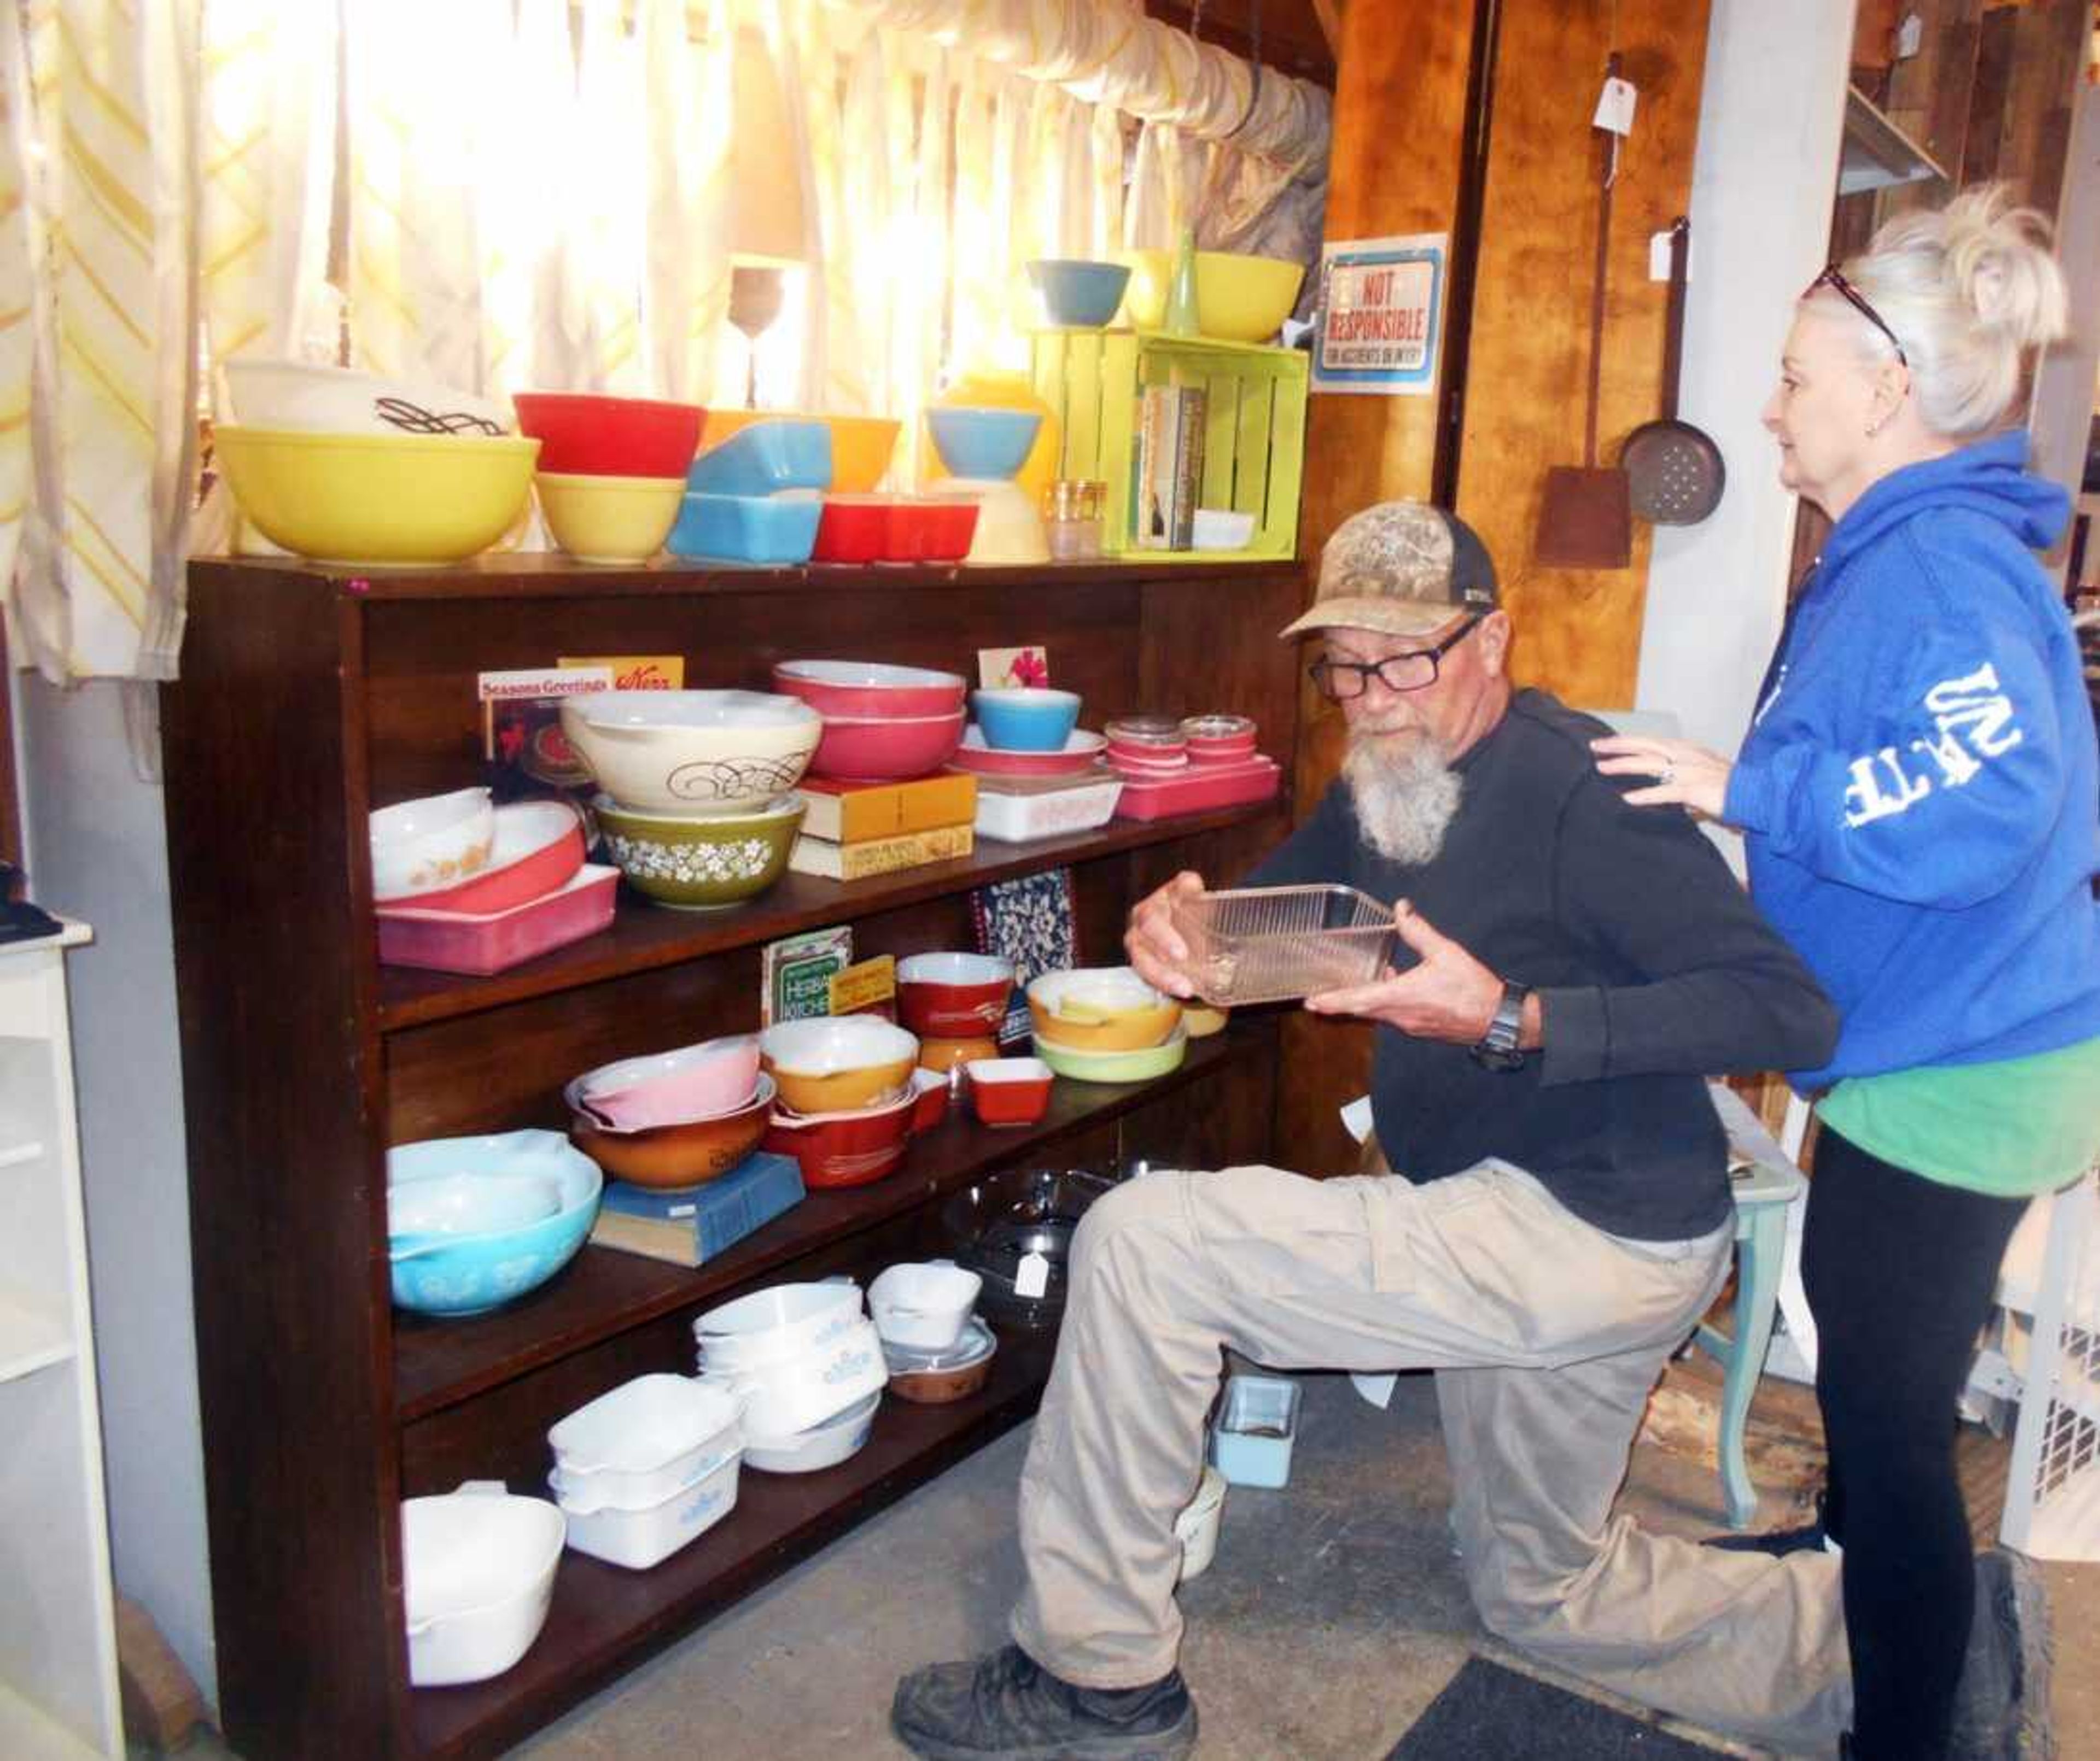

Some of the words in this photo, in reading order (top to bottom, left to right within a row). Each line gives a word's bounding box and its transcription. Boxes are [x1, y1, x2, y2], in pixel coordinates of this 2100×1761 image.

[1363, 271, 1395, 306] NOT
[1328, 308, 1425, 340] RESPONSIBLE
[483, 681, 540, 695] Seasons
[543, 677, 608, 693] Greetings
